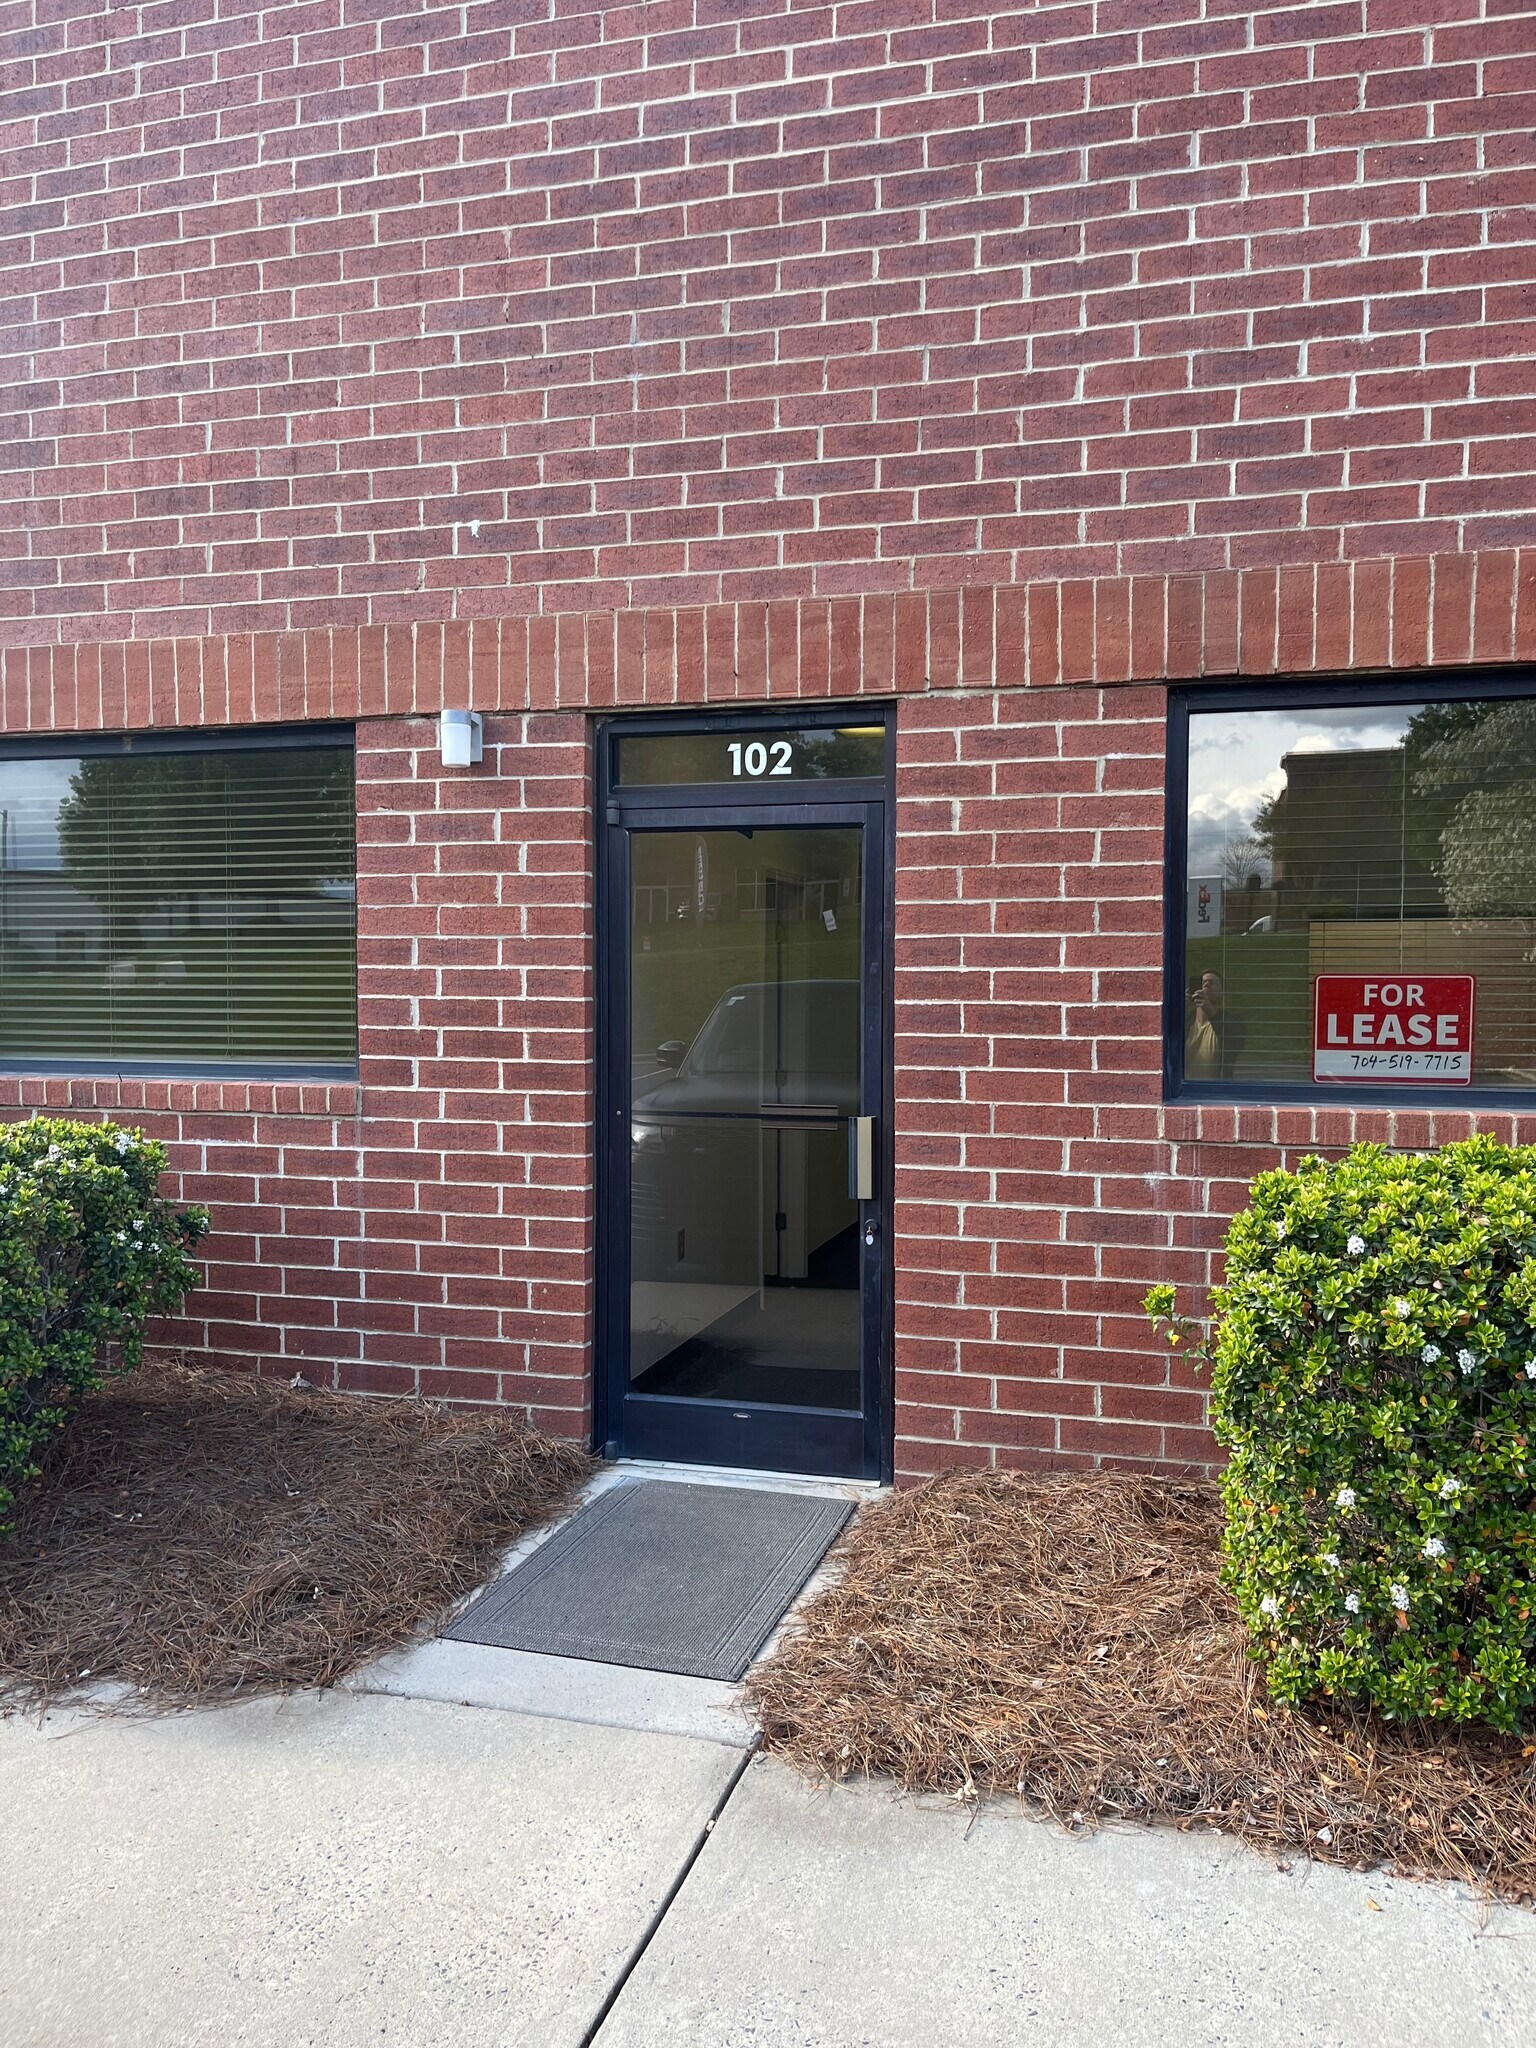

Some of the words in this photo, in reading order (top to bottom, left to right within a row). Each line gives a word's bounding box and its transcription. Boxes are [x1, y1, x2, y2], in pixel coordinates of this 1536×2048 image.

[727, 741, 793, 776] 102
[1363, 983, 1425, 1007] FOR
[1327, 1013, 1459, 1046] LEASE
[1350, 1054, 1462, 1071] 704-519-7715
